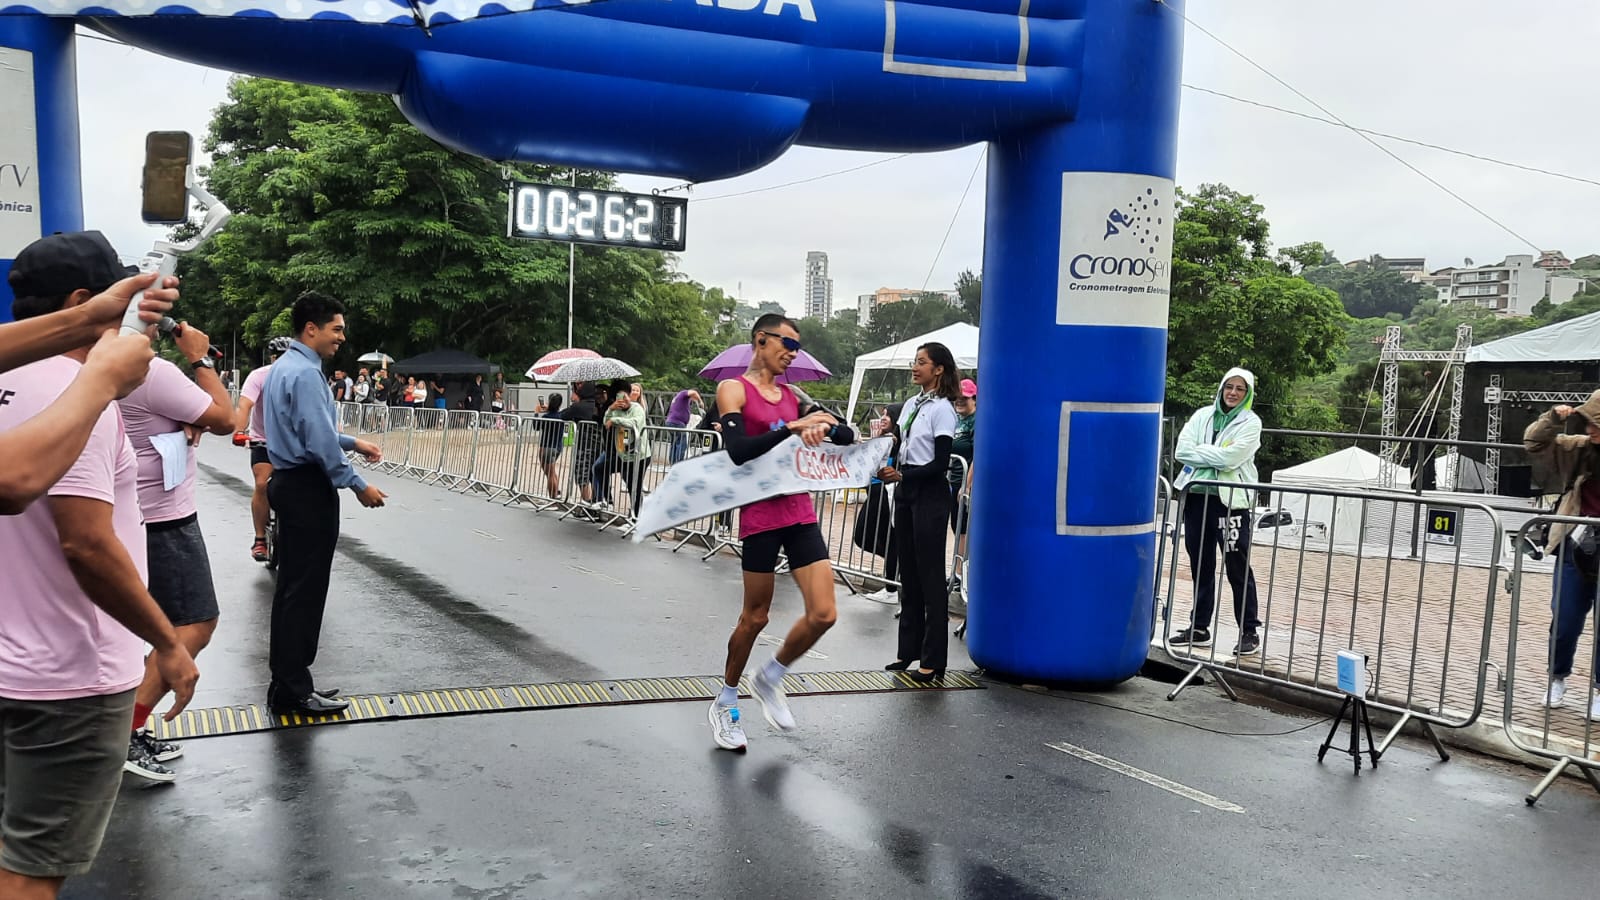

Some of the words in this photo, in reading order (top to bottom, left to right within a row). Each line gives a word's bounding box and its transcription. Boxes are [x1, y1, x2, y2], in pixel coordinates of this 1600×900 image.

[516, 187, 682, 242] 00:26:21
[1069, 282, 1145, 294] Cronometragem
[1434, 516, 1450, 531] 81
